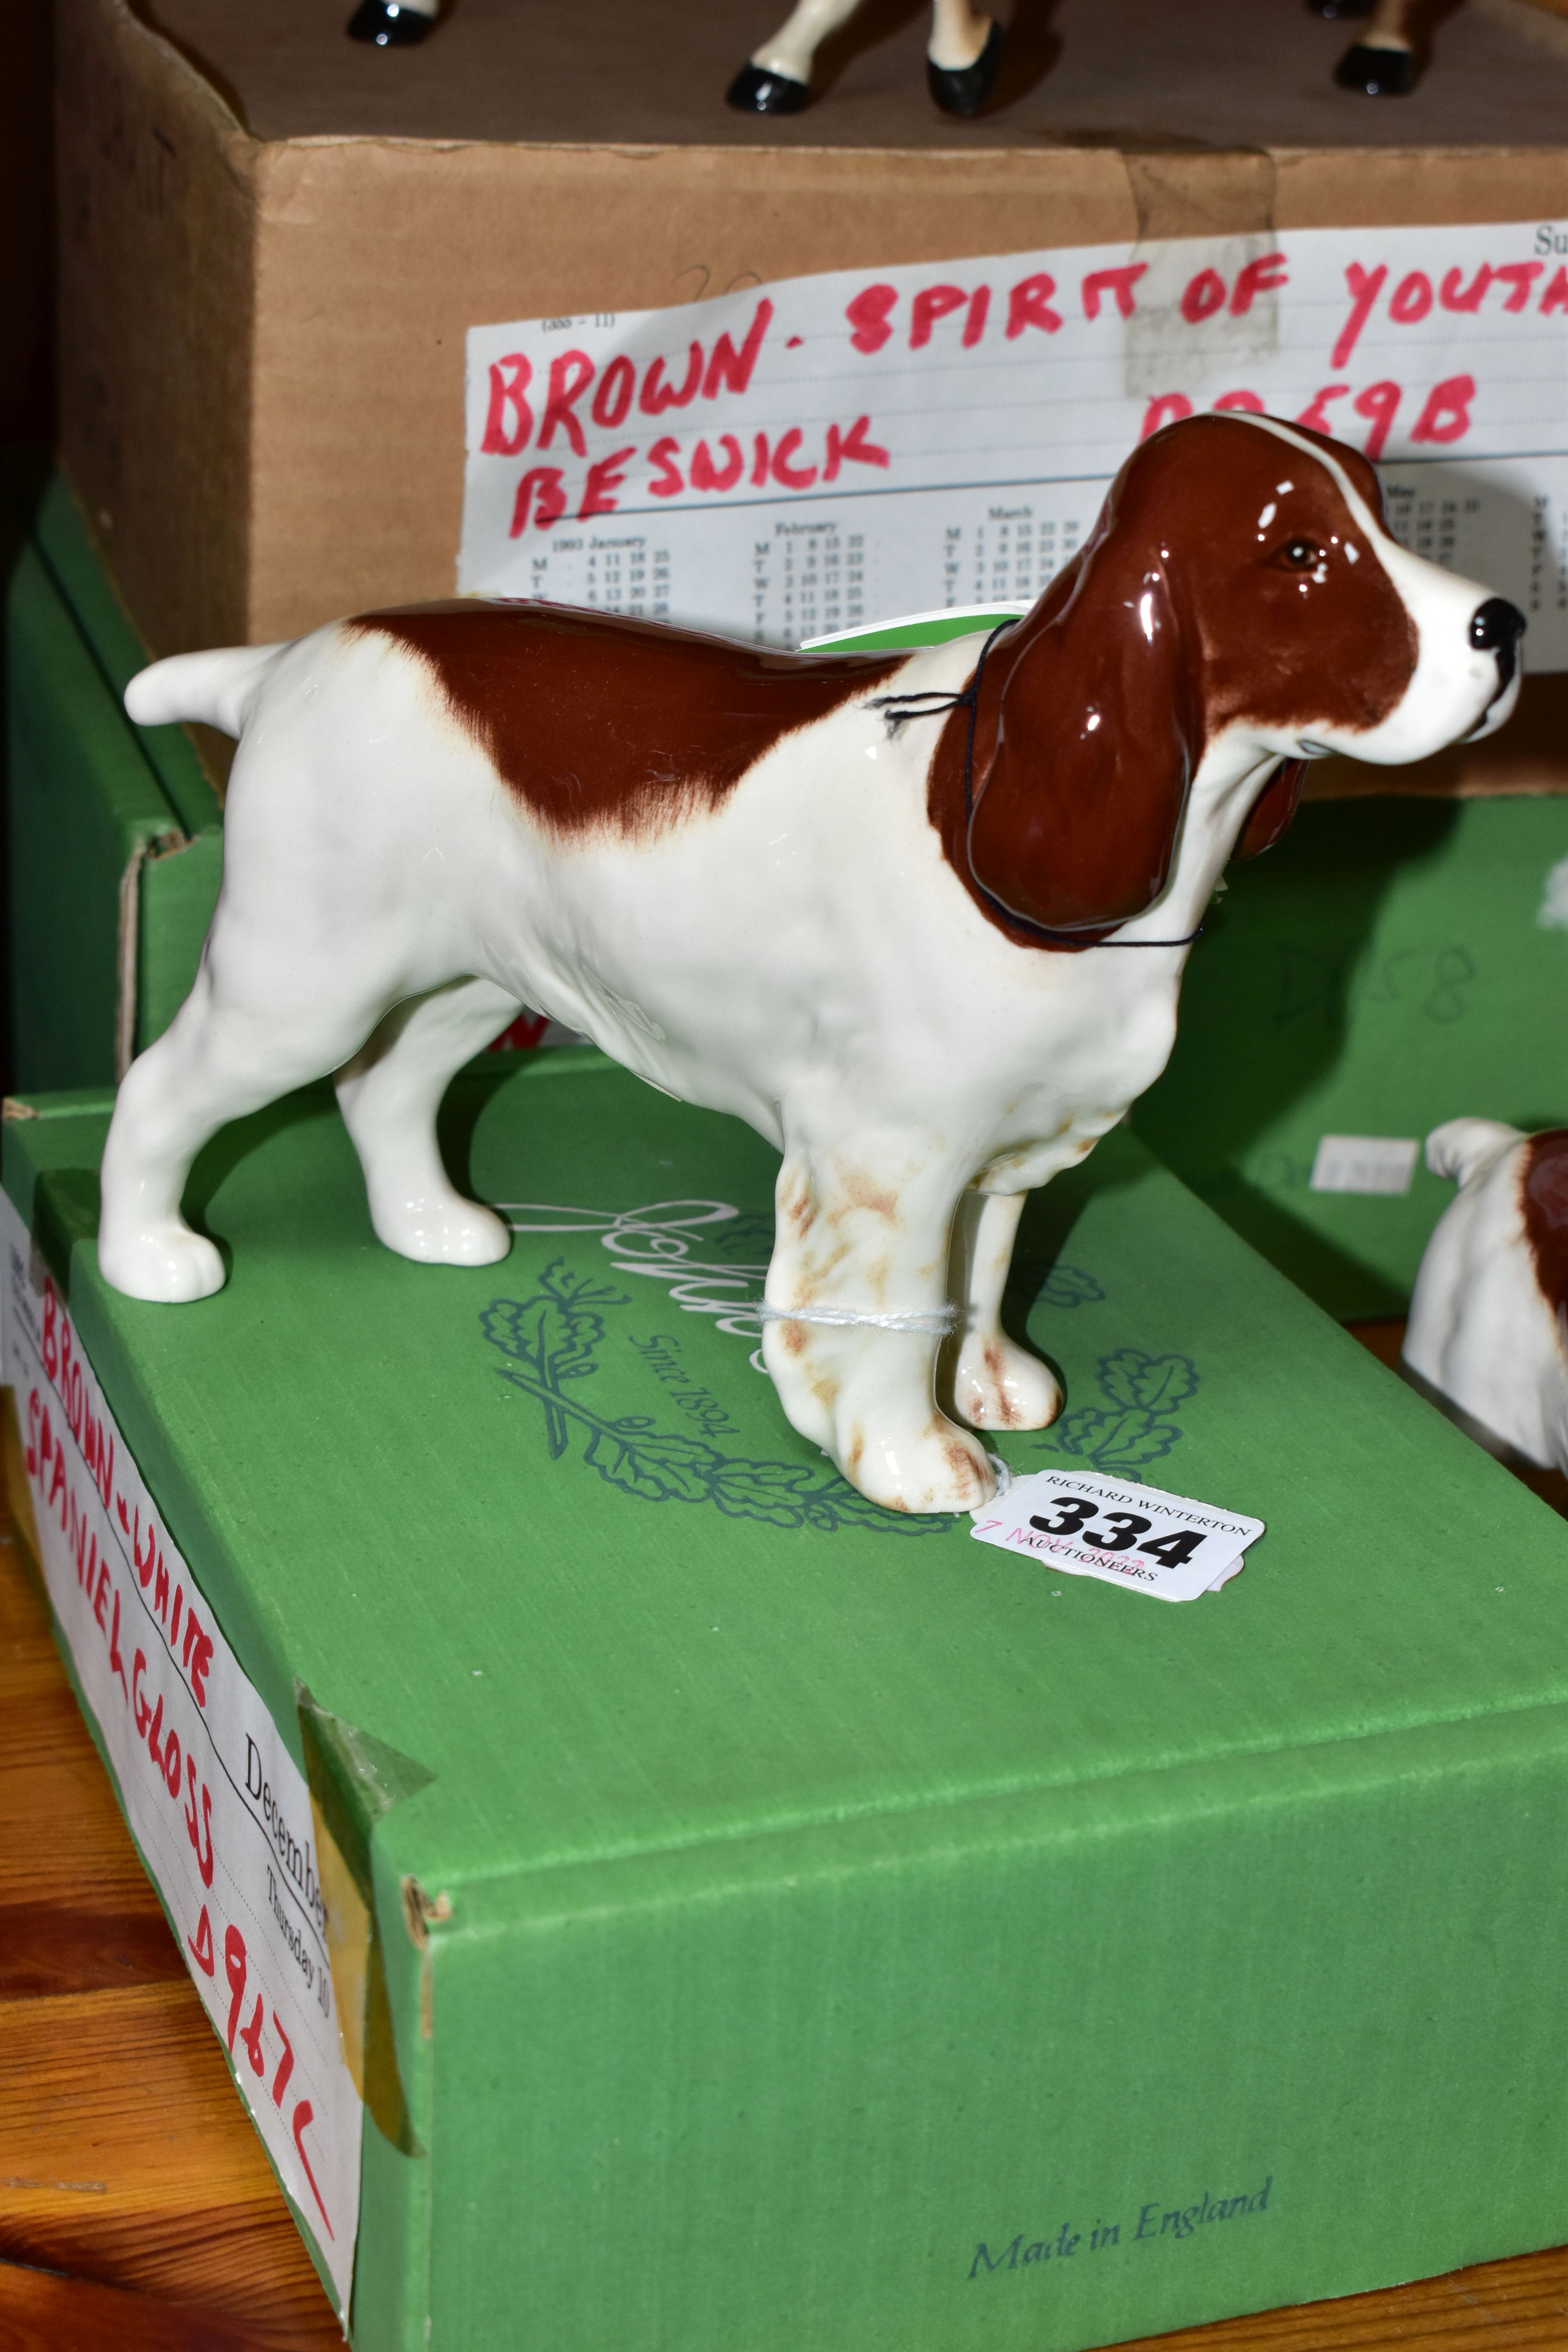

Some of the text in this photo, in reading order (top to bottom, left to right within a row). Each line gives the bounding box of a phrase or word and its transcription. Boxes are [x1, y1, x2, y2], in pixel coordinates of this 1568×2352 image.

[845, 262, 1149, 355] SPIRIT
[1180, 252, 1289, 325] OF
[508, 416, 890, 539] BESWICK
[988, 506, 1032, 521] March
[590, 537, 646, 550] January
[776, 522, 836, 536] February
[628, 1334, 741, 1438] Since 1894
[975, 1520, 1002, 1533] 7
[1005, 1527, 1073, 1553] NOV
[1029, 1497, 1208, 1569] 334
[1044, 1476, 1252, 1536] RICHARD WINTERTON
[1020, 1537, 1158, 1581] AUCTIONEERS
[132, 1647, 214, 1889] GLOSS
[245, 1732, 330, 1944] December
[267, 1864, 329, 2018] Thursday 10
[967, 2175, 1273, 2280] Made in England
